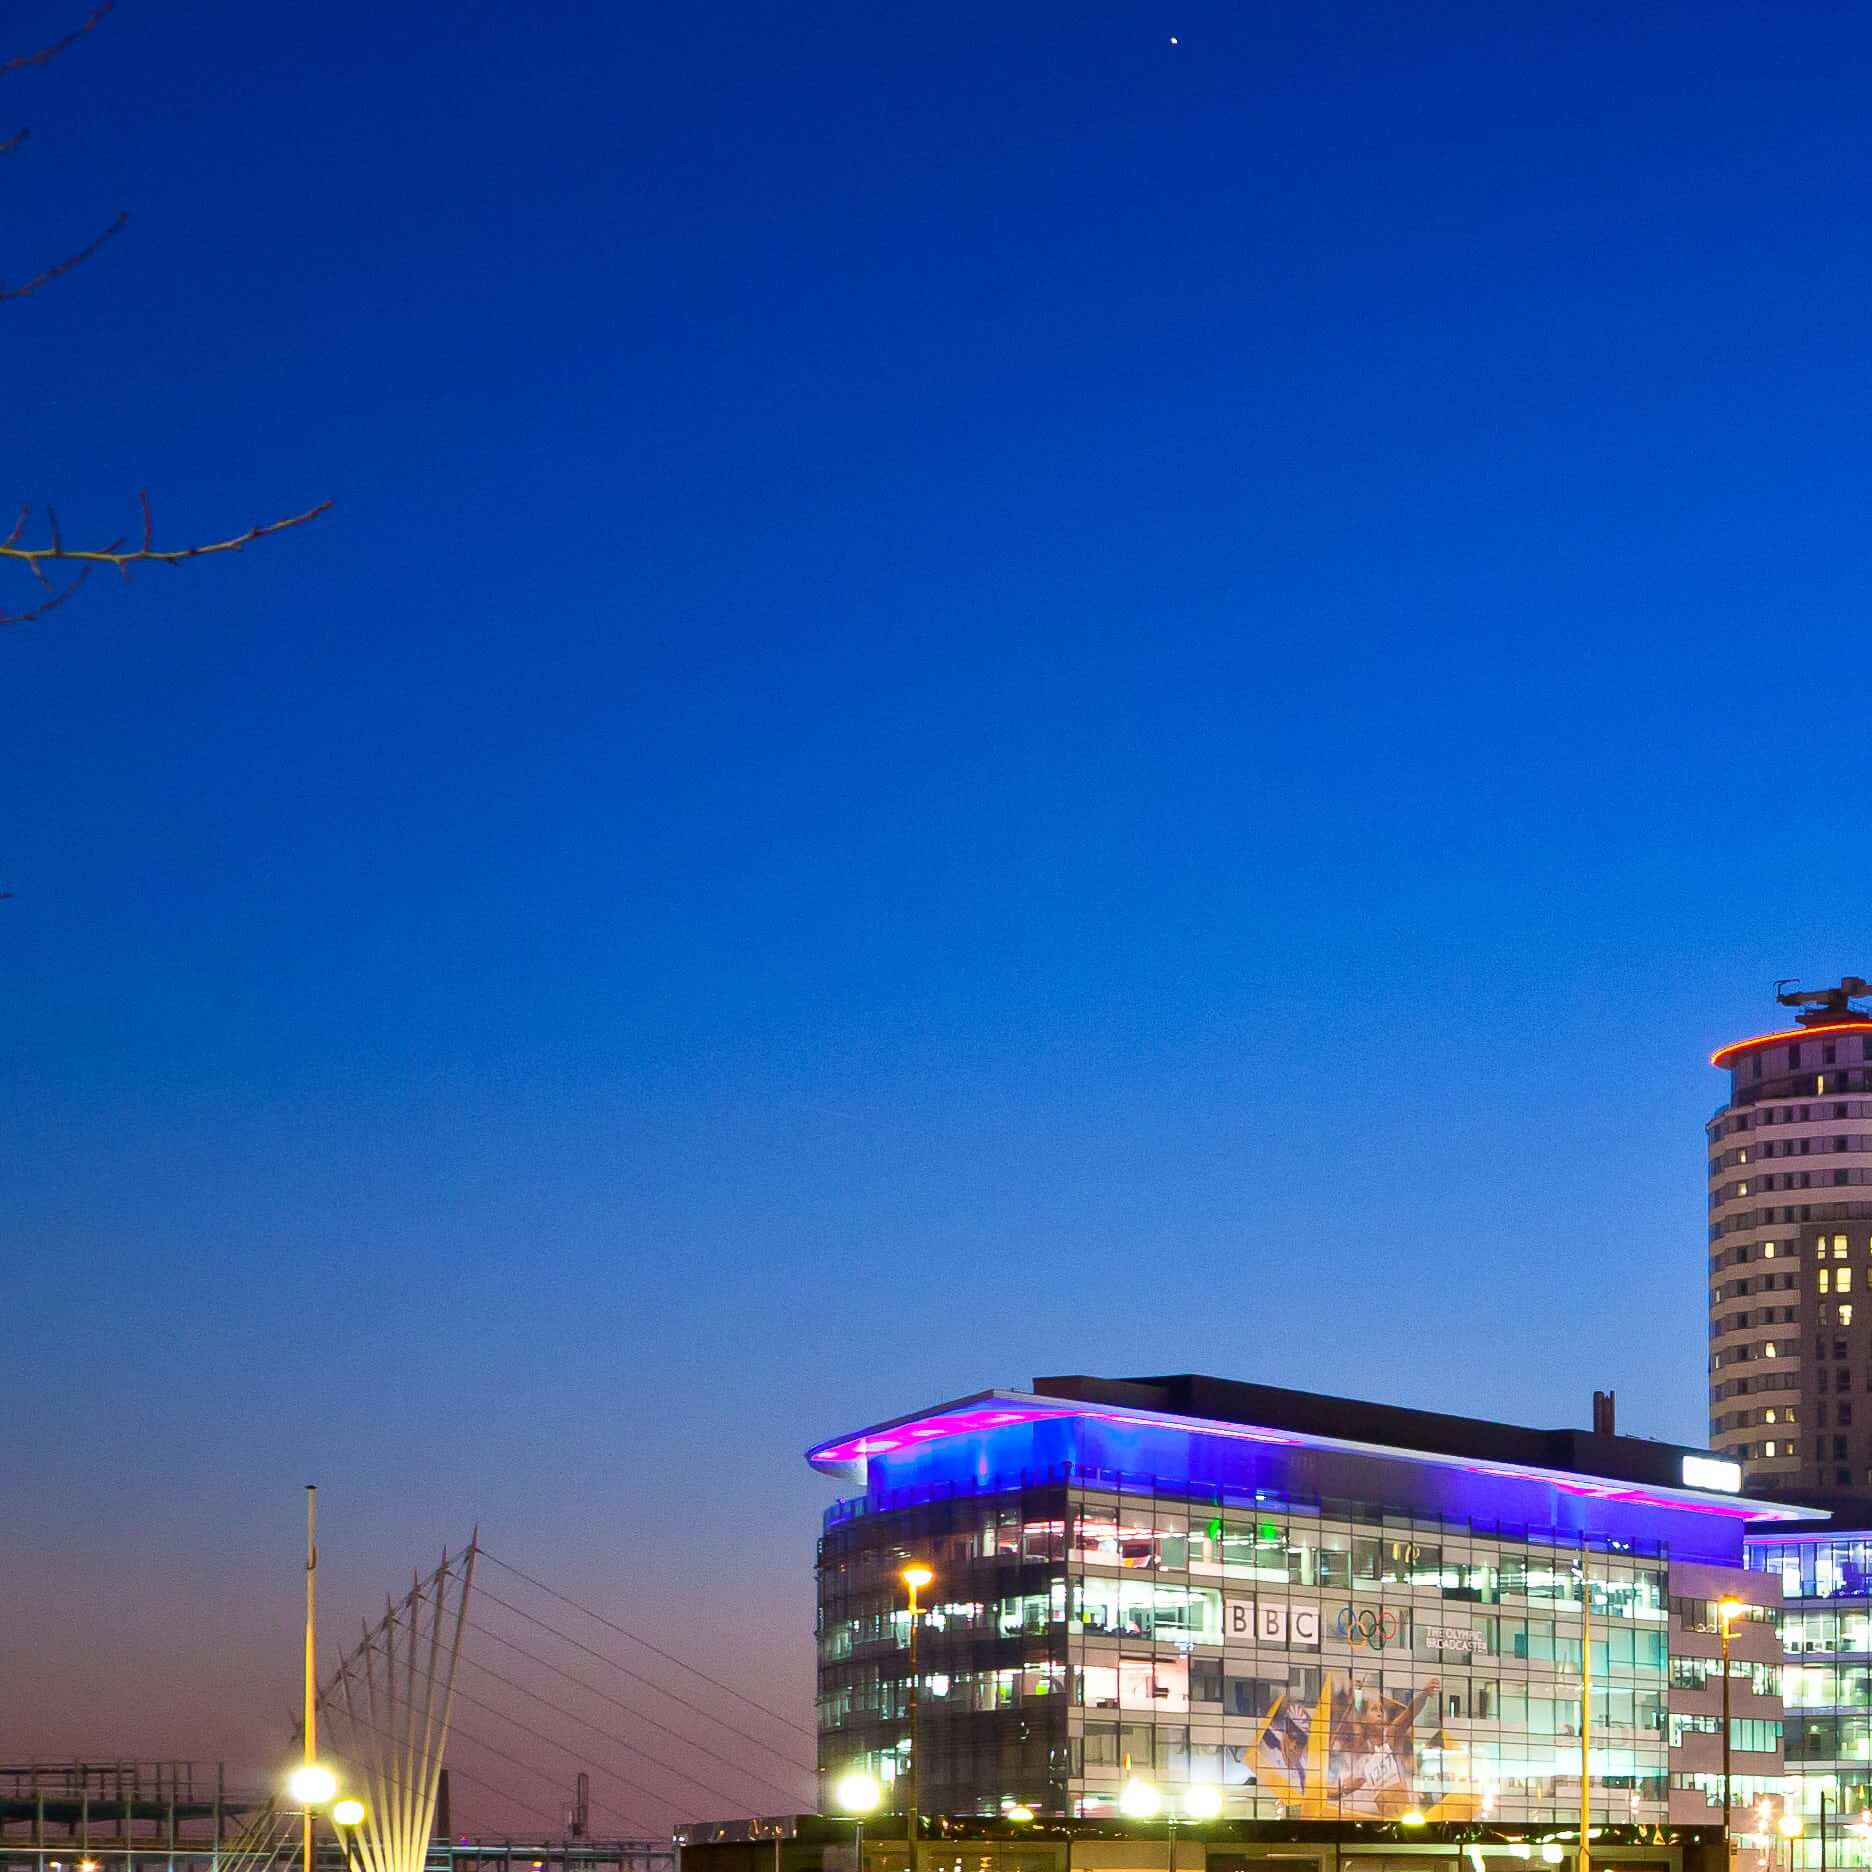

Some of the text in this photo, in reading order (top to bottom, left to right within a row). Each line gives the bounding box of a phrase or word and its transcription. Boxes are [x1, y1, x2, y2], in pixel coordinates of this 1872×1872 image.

[1233, 1606, 1313, 1638] BBC
[1426, 1626, 1444, 1638] THE
[1426, 1637, 1488, 1656] BROADCASTER
